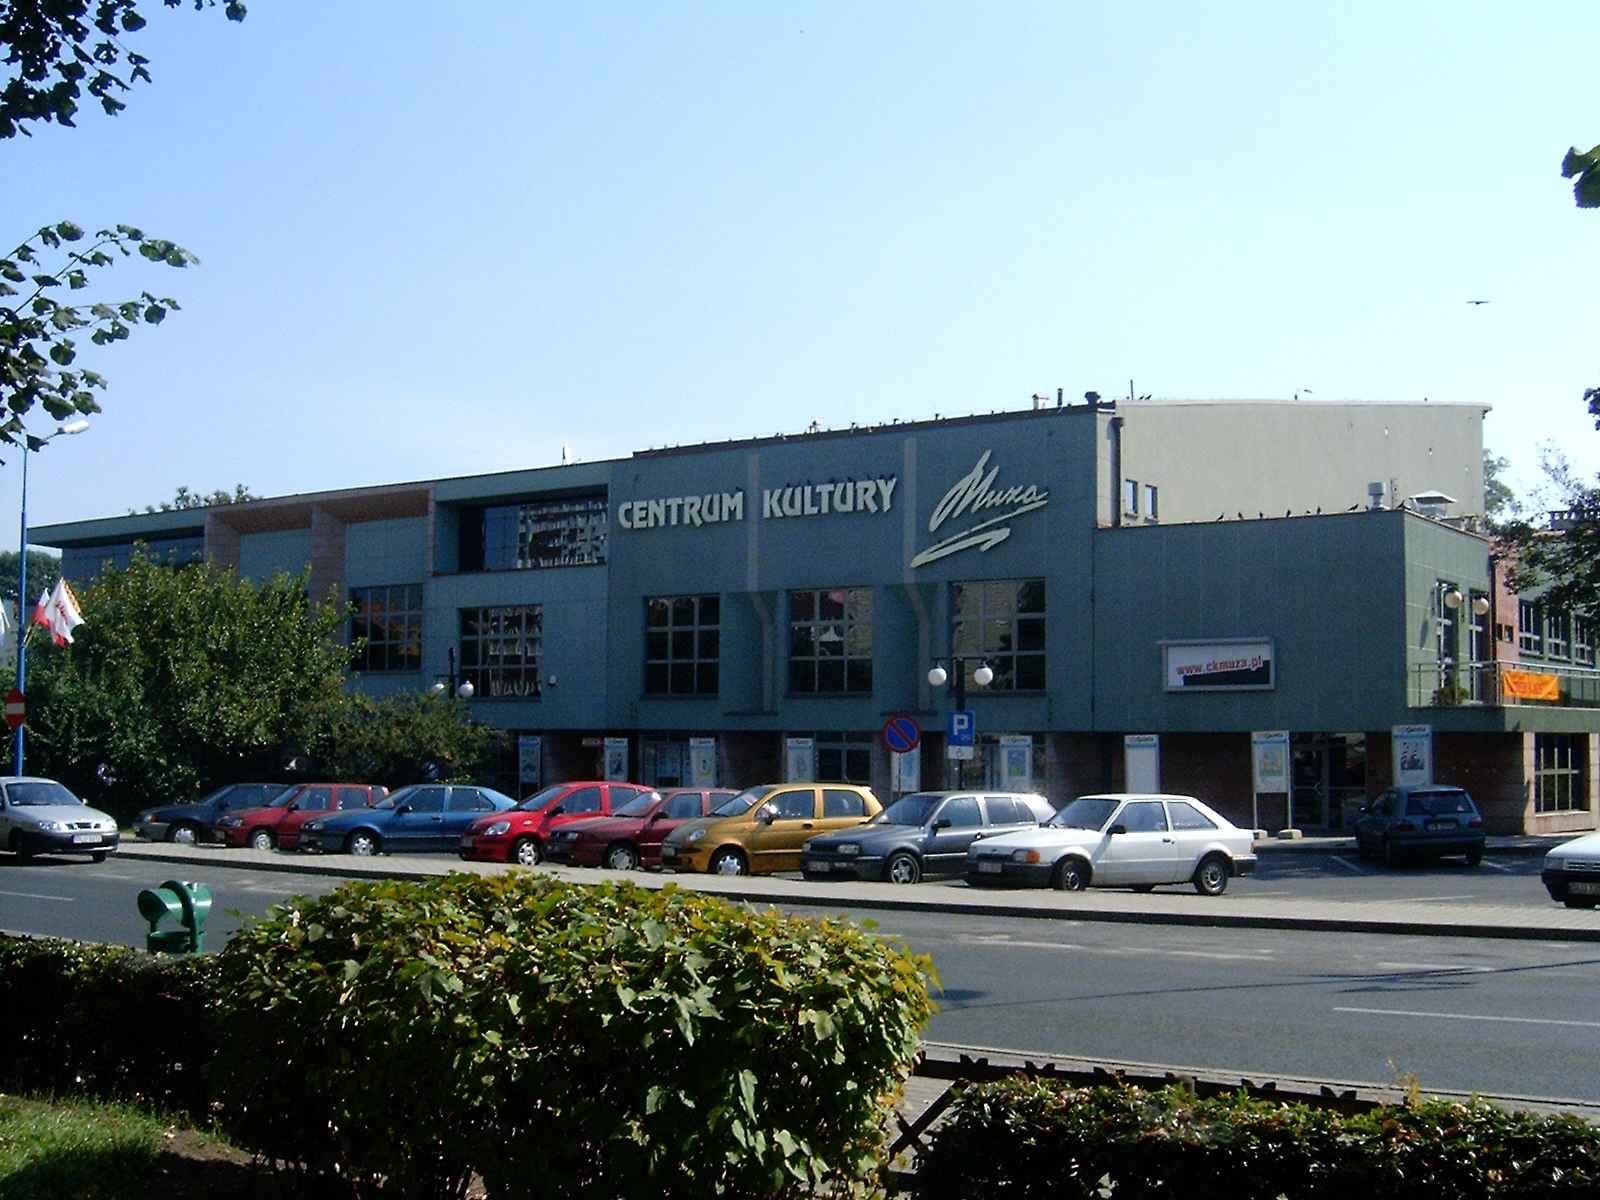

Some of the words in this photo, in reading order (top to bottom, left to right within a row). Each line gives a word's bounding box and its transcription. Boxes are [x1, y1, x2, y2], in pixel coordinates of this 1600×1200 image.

[618, 491, 744, 529] CENTRUM
[762, 478, 897, 518] KULTURY
[953, 714, 969, 735] P
